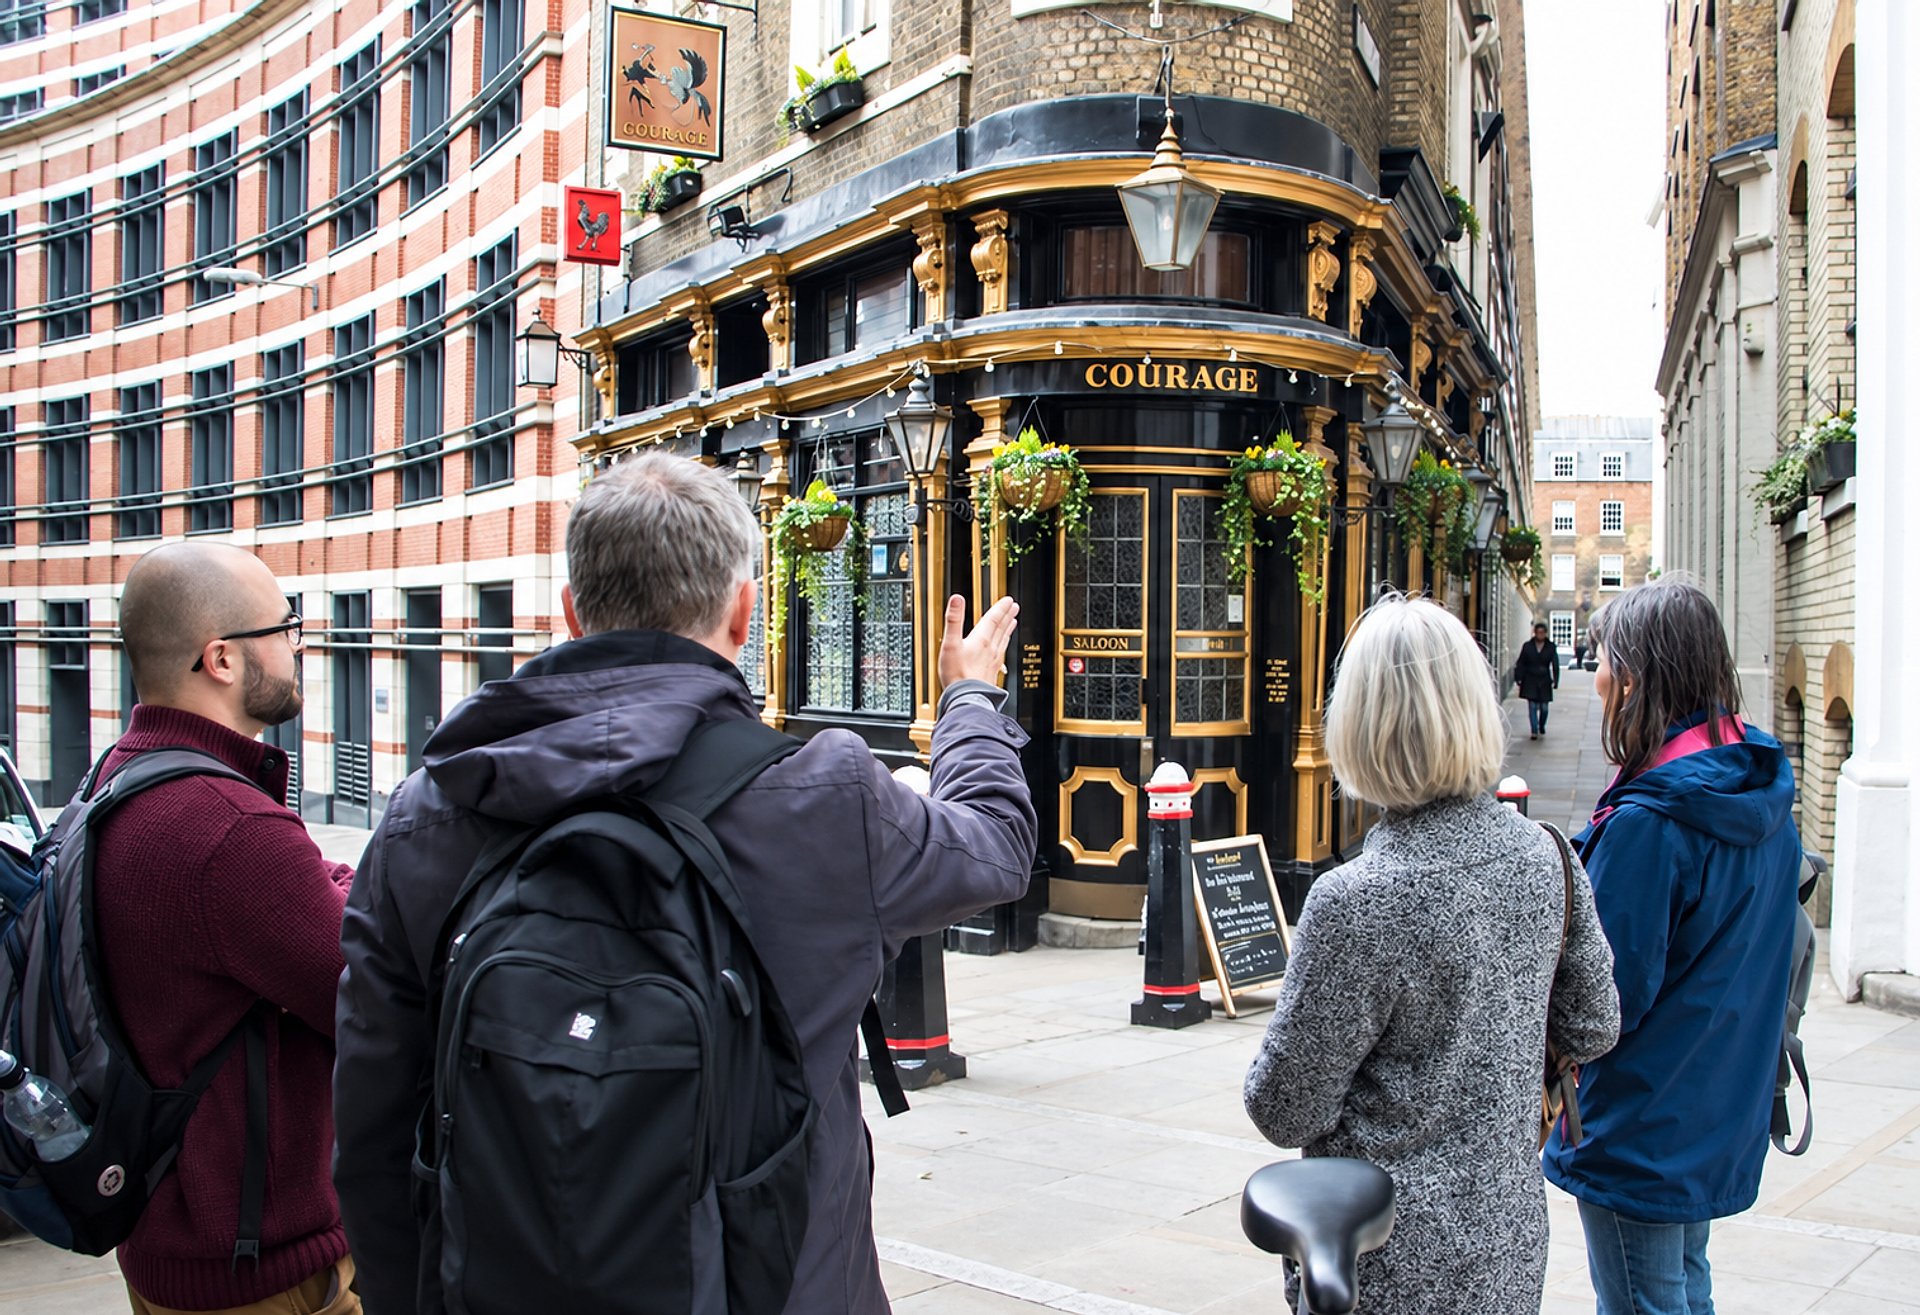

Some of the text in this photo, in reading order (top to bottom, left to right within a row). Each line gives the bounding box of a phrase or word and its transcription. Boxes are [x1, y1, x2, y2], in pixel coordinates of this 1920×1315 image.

[623, 122, 708, 146] COURAGE
[1085, 363, 1258, 392] COURAGE
[1073, 637, 1129, 650] SALOON
